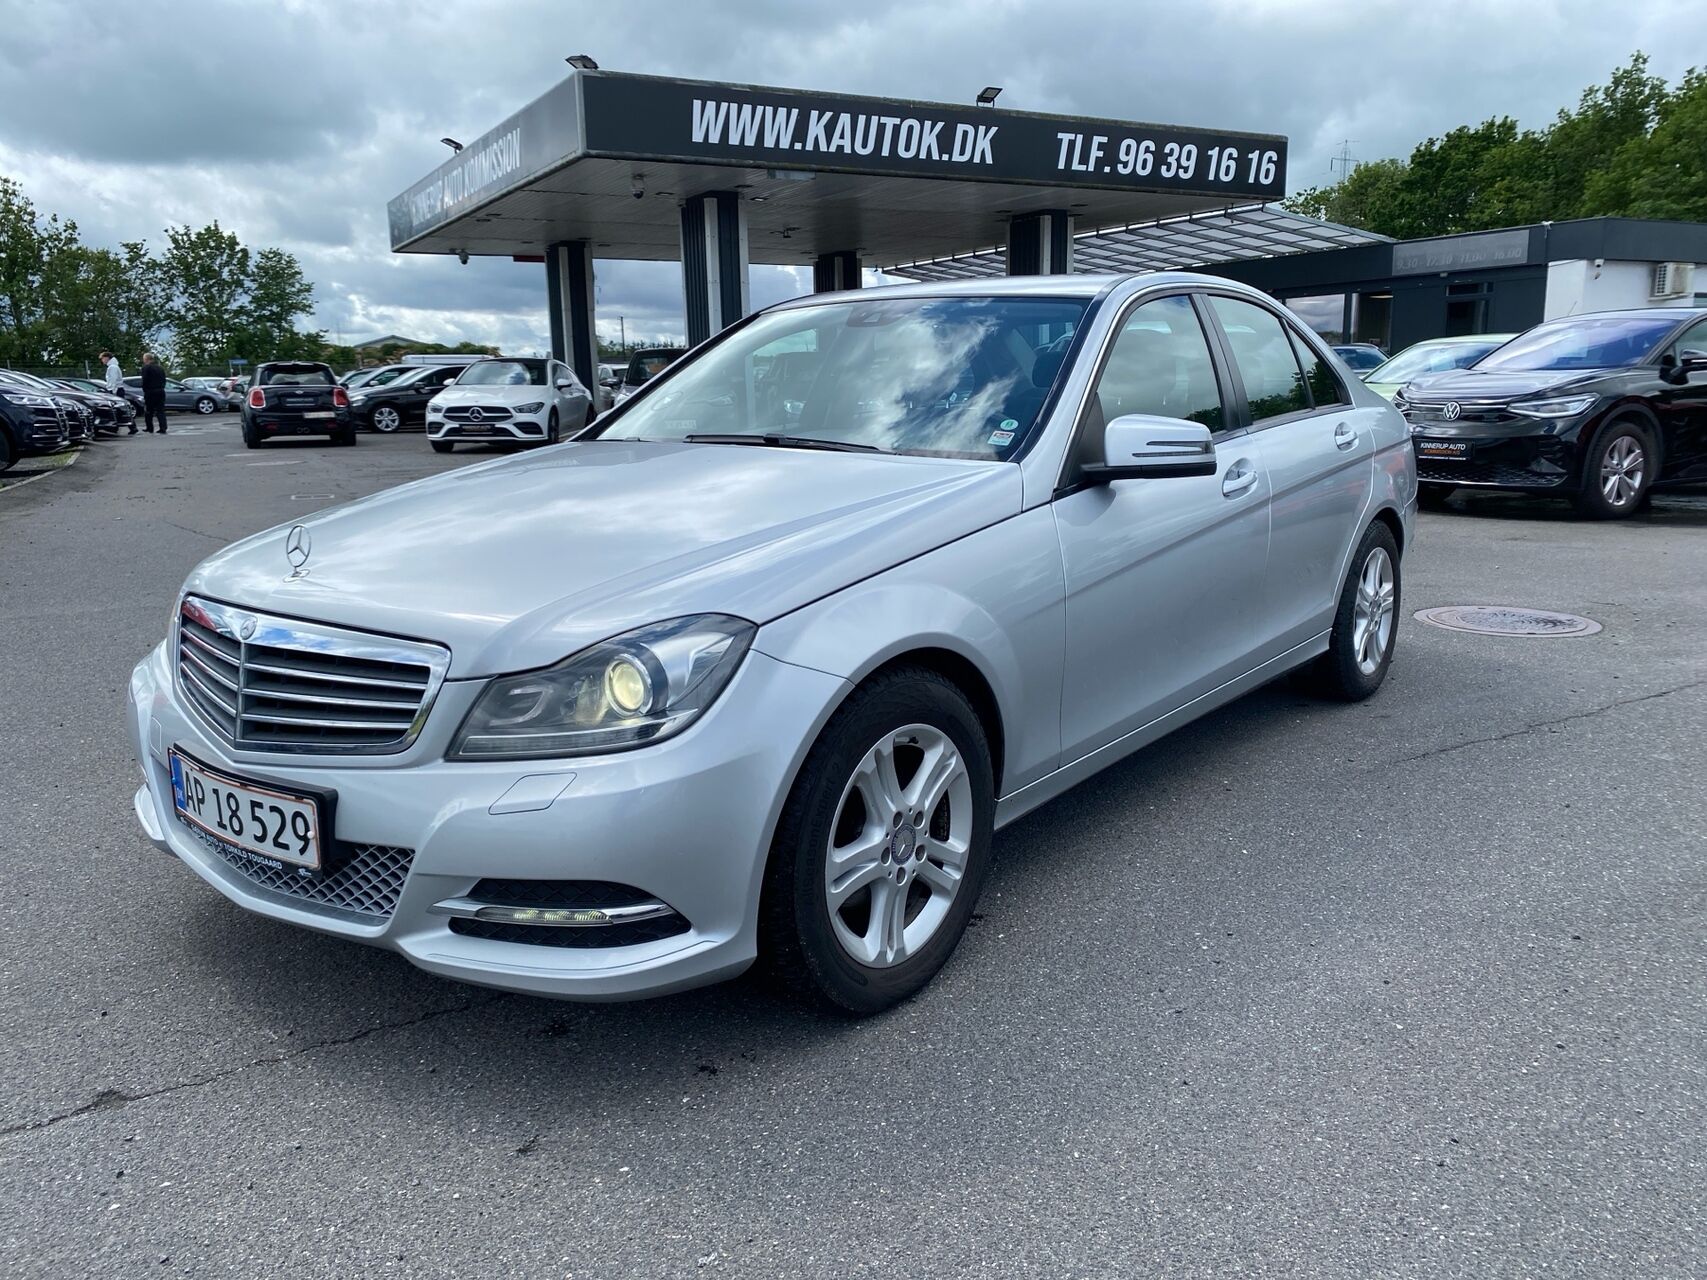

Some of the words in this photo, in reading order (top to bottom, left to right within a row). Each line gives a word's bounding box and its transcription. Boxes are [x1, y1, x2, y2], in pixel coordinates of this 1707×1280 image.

[444, 166, 463, 208] AUTO
[464, 128, 520, 198] KOMMISSION
[691, 99, 999, 166] WWW.KAUTOK.DK
[1056, 132, 1111, 173] TLF.
[1117, 138, 1154, 177] 96
[1161, 141, 1196, 180] 39
[1207, 146, 1237, 183] 16
[1248, 150, 1279, 186] 16
[185, 771, 206, 816] AP
[211, 788, 244, 837] 18
[250, 800, 310, 857] 529
